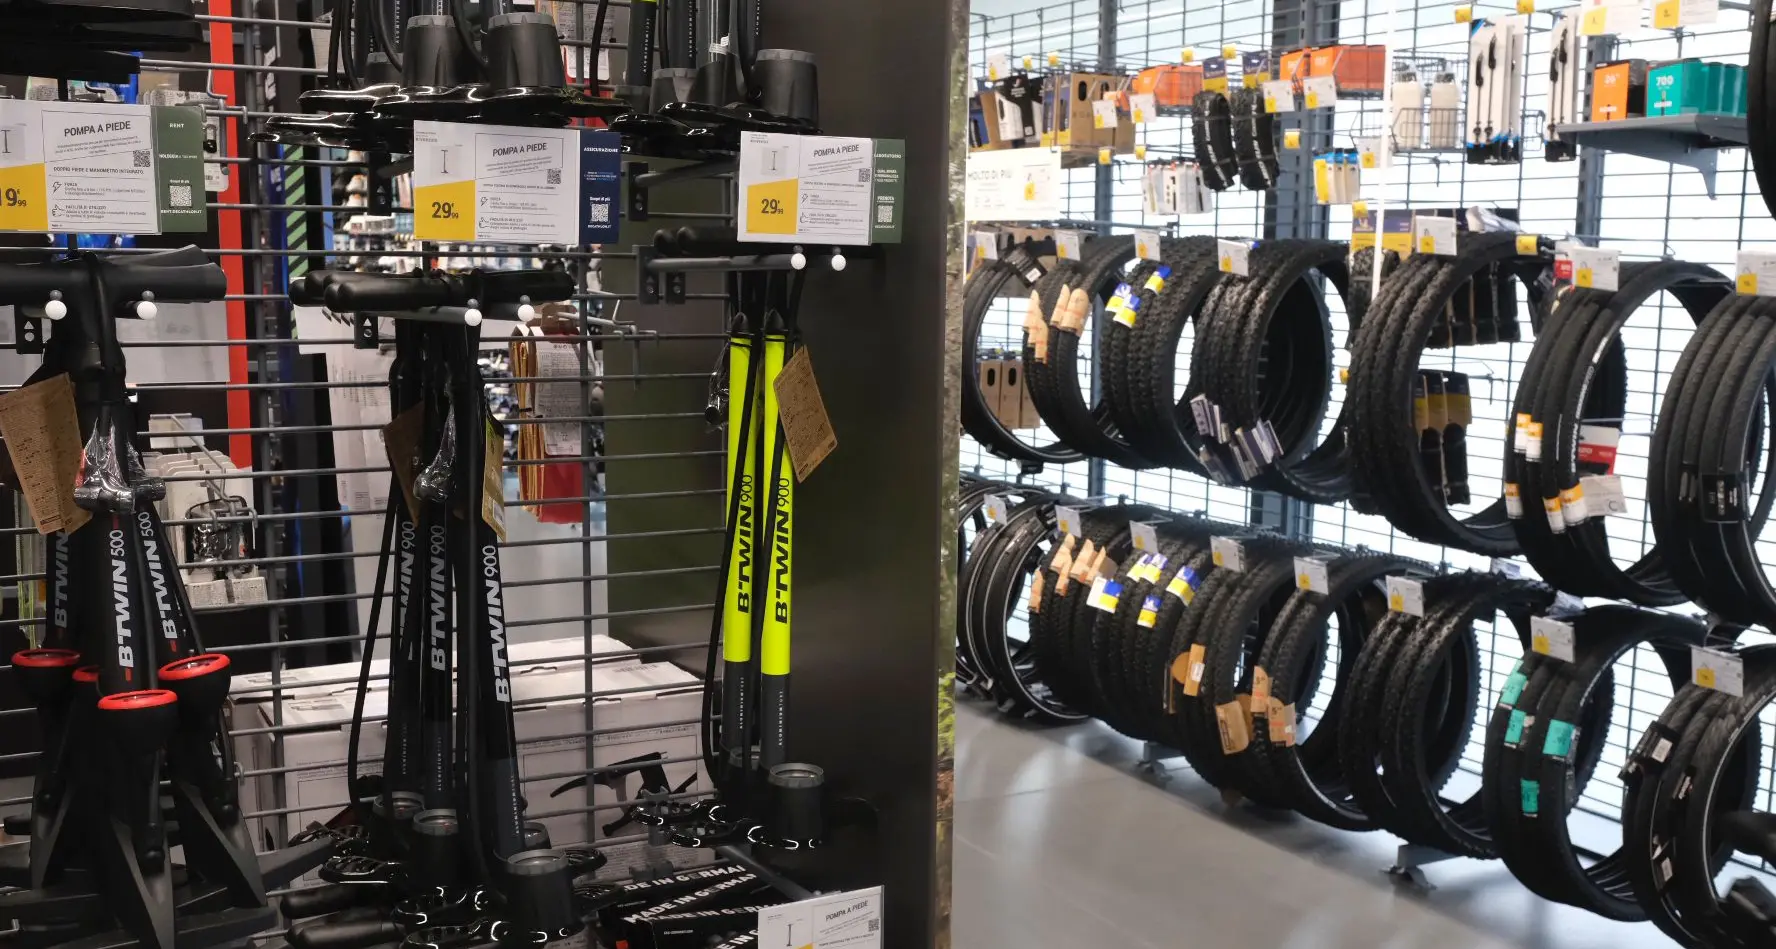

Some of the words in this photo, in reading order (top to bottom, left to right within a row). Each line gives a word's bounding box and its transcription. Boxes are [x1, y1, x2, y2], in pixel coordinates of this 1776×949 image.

[1655, 74, 1674, 87] 700
[64, 125, 96, 138] POMPA
[97, 124, 104, 133] A
[106, 120, 131, 132] PIEDE
[492, 145, 519, 157] POMPA
[519, 144, 526, 153] A
[526, 142, 547, 153] PIEDE
[814, 148, 835, 158] POMPA
[841, 145, 860, 154] PIEDE
[740, 474, 753, 502] 900
[777, 478, 790, 507] 900
[137, 511, 154, 537] 500
[401, 521, 416, 550] 900
[109, 529, 125, 557] 500
[430, 525, 445, 555] 900
[482, 544, 499, 577] 900
[652, 877, 675, 886] IN
[623, 902, 678, 925] MADE
[673, 895, 697, 905] IN
[825, 908, 847, 921] POMPA
[852, 900, 869, 911] PIEDE
[729, 934, 755, 945] IN
